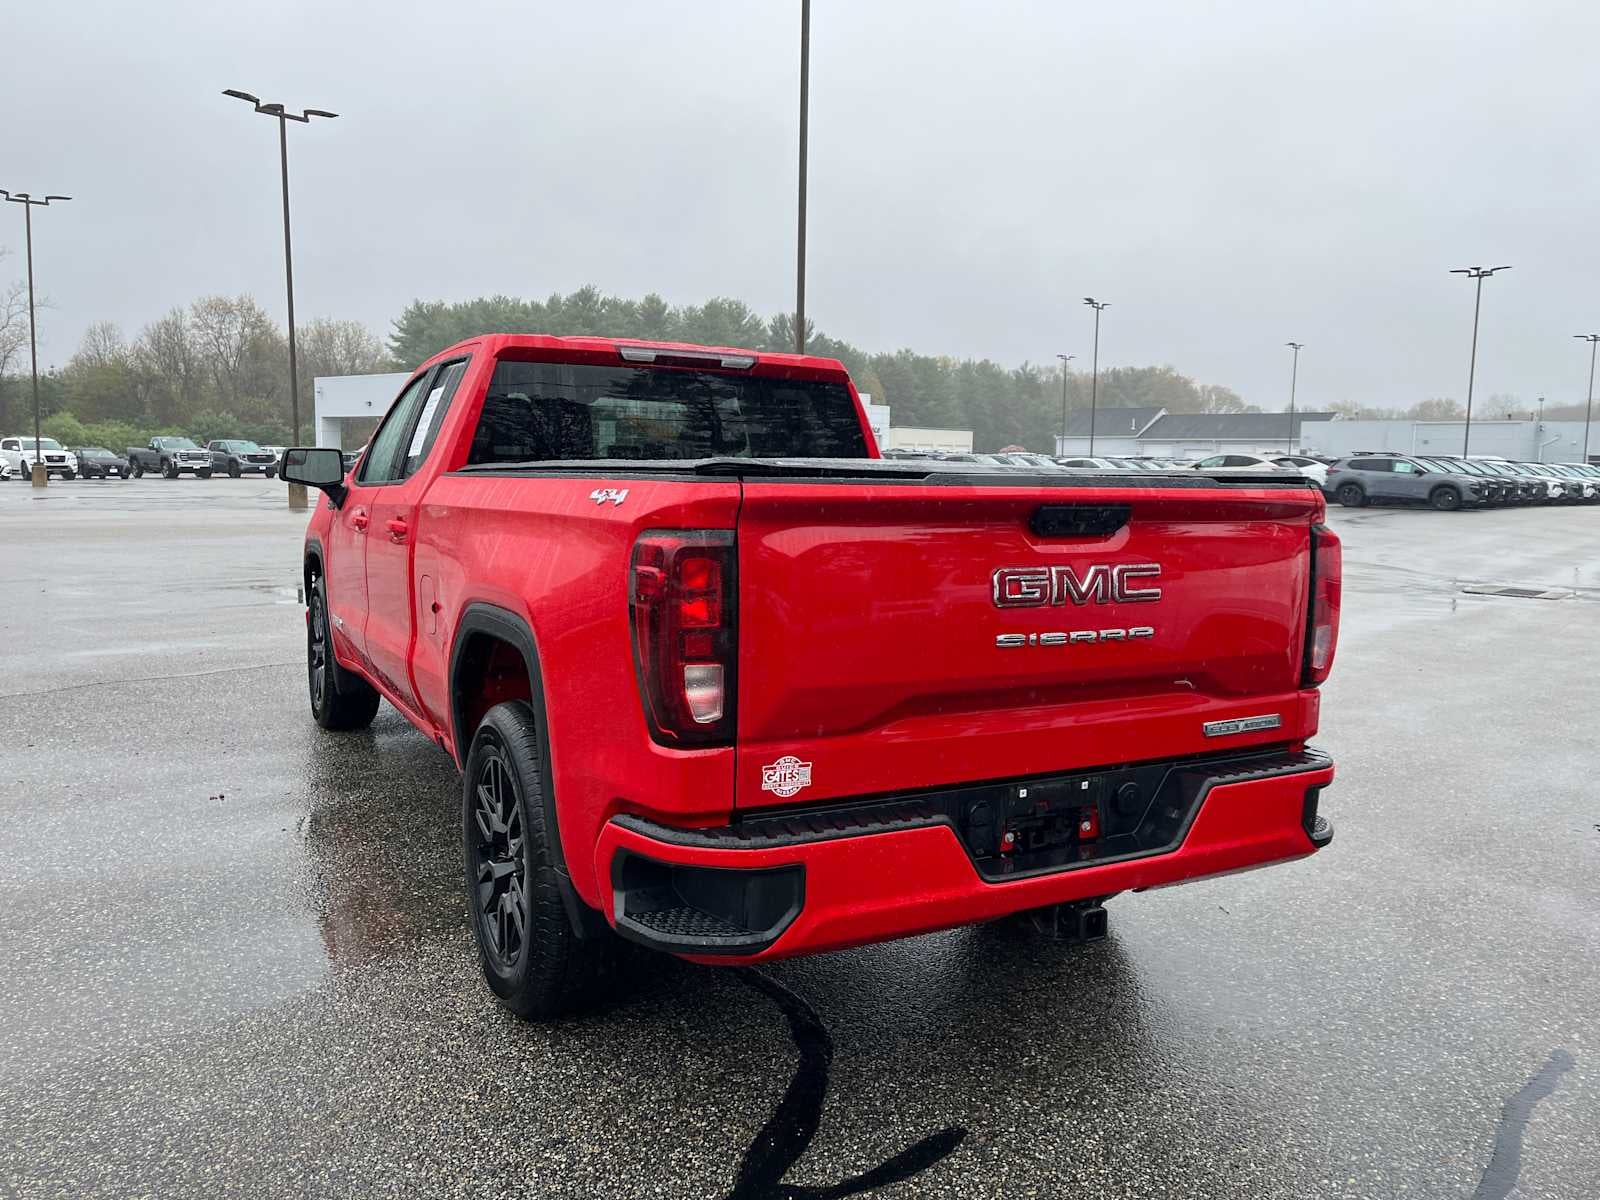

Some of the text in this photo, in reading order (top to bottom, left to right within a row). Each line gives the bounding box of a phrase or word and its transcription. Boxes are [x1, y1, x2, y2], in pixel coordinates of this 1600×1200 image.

[992, 563, 1161, 607] GMC
[995, 626, 1155, 648] SIERRA
[765, 769, 800, 783] GATES
